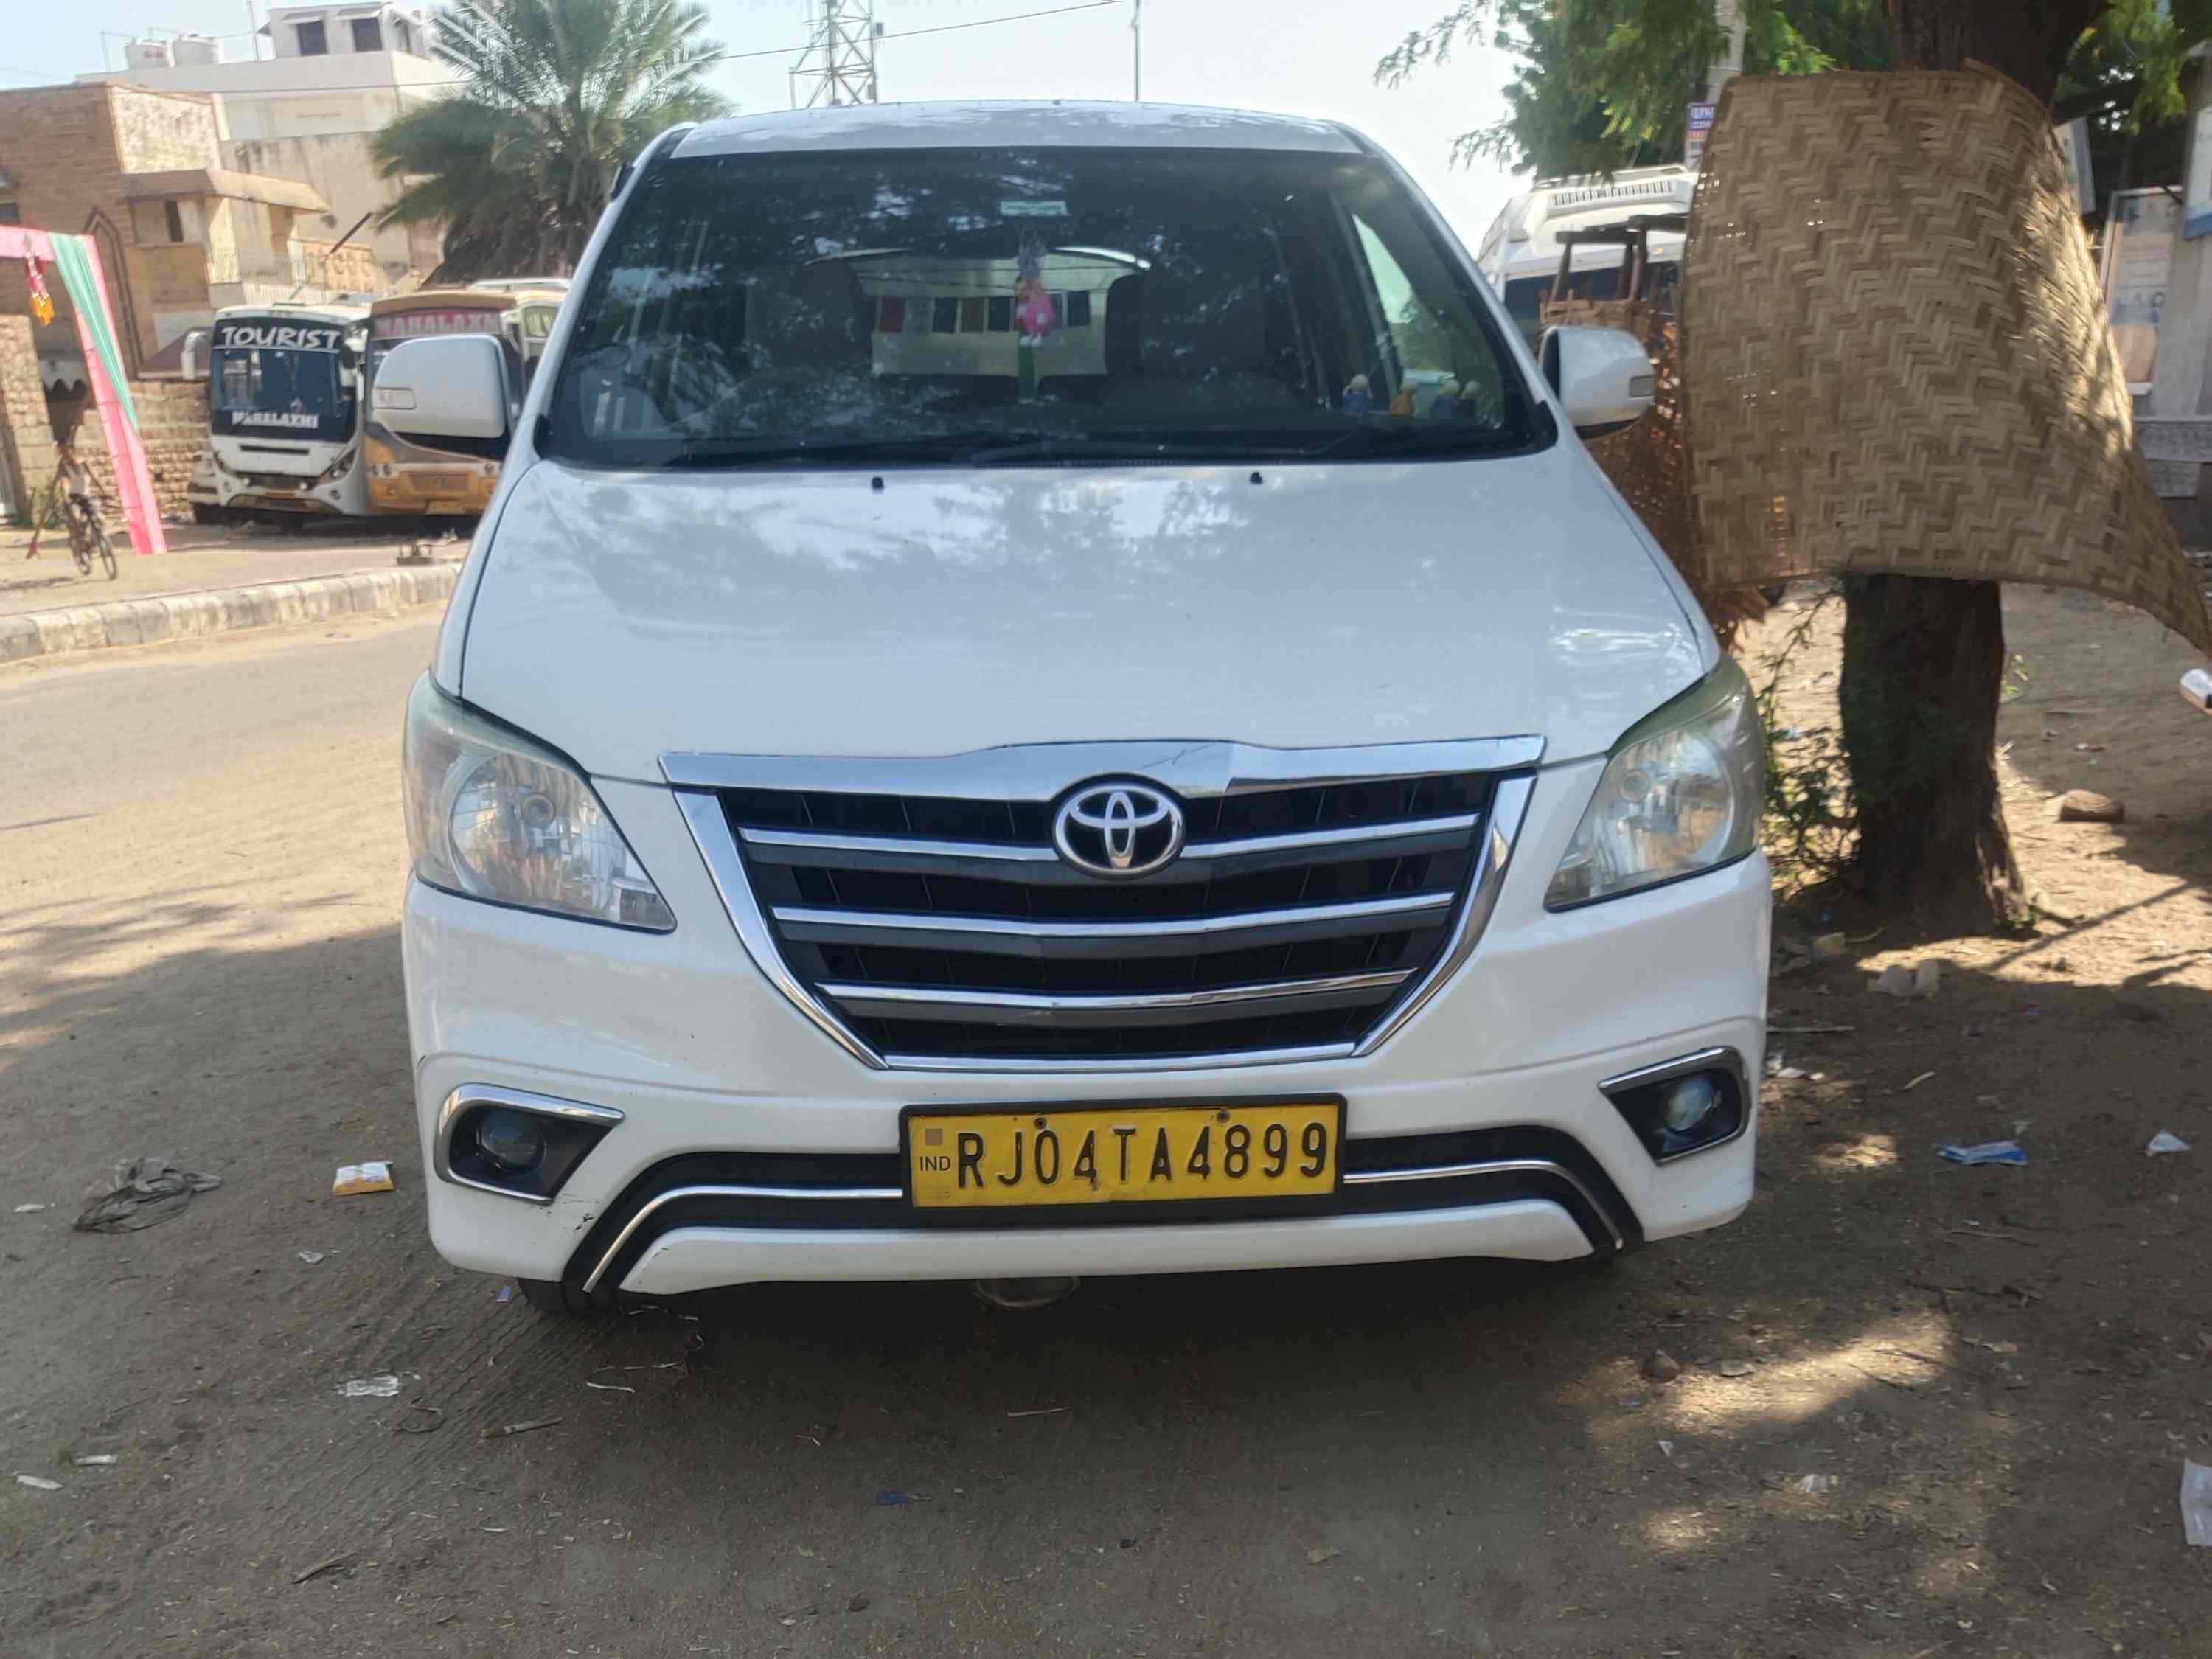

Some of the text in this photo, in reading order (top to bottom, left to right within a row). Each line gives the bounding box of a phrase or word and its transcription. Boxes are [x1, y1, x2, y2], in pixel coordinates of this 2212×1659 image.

[374, 312, 501, 335] MAHALAXM
[221, 326, 341, 351] TOURIST
[919, 1155, 951, 1172] IND
[958, 1123, 1326, 1188] RJ04TA4899
